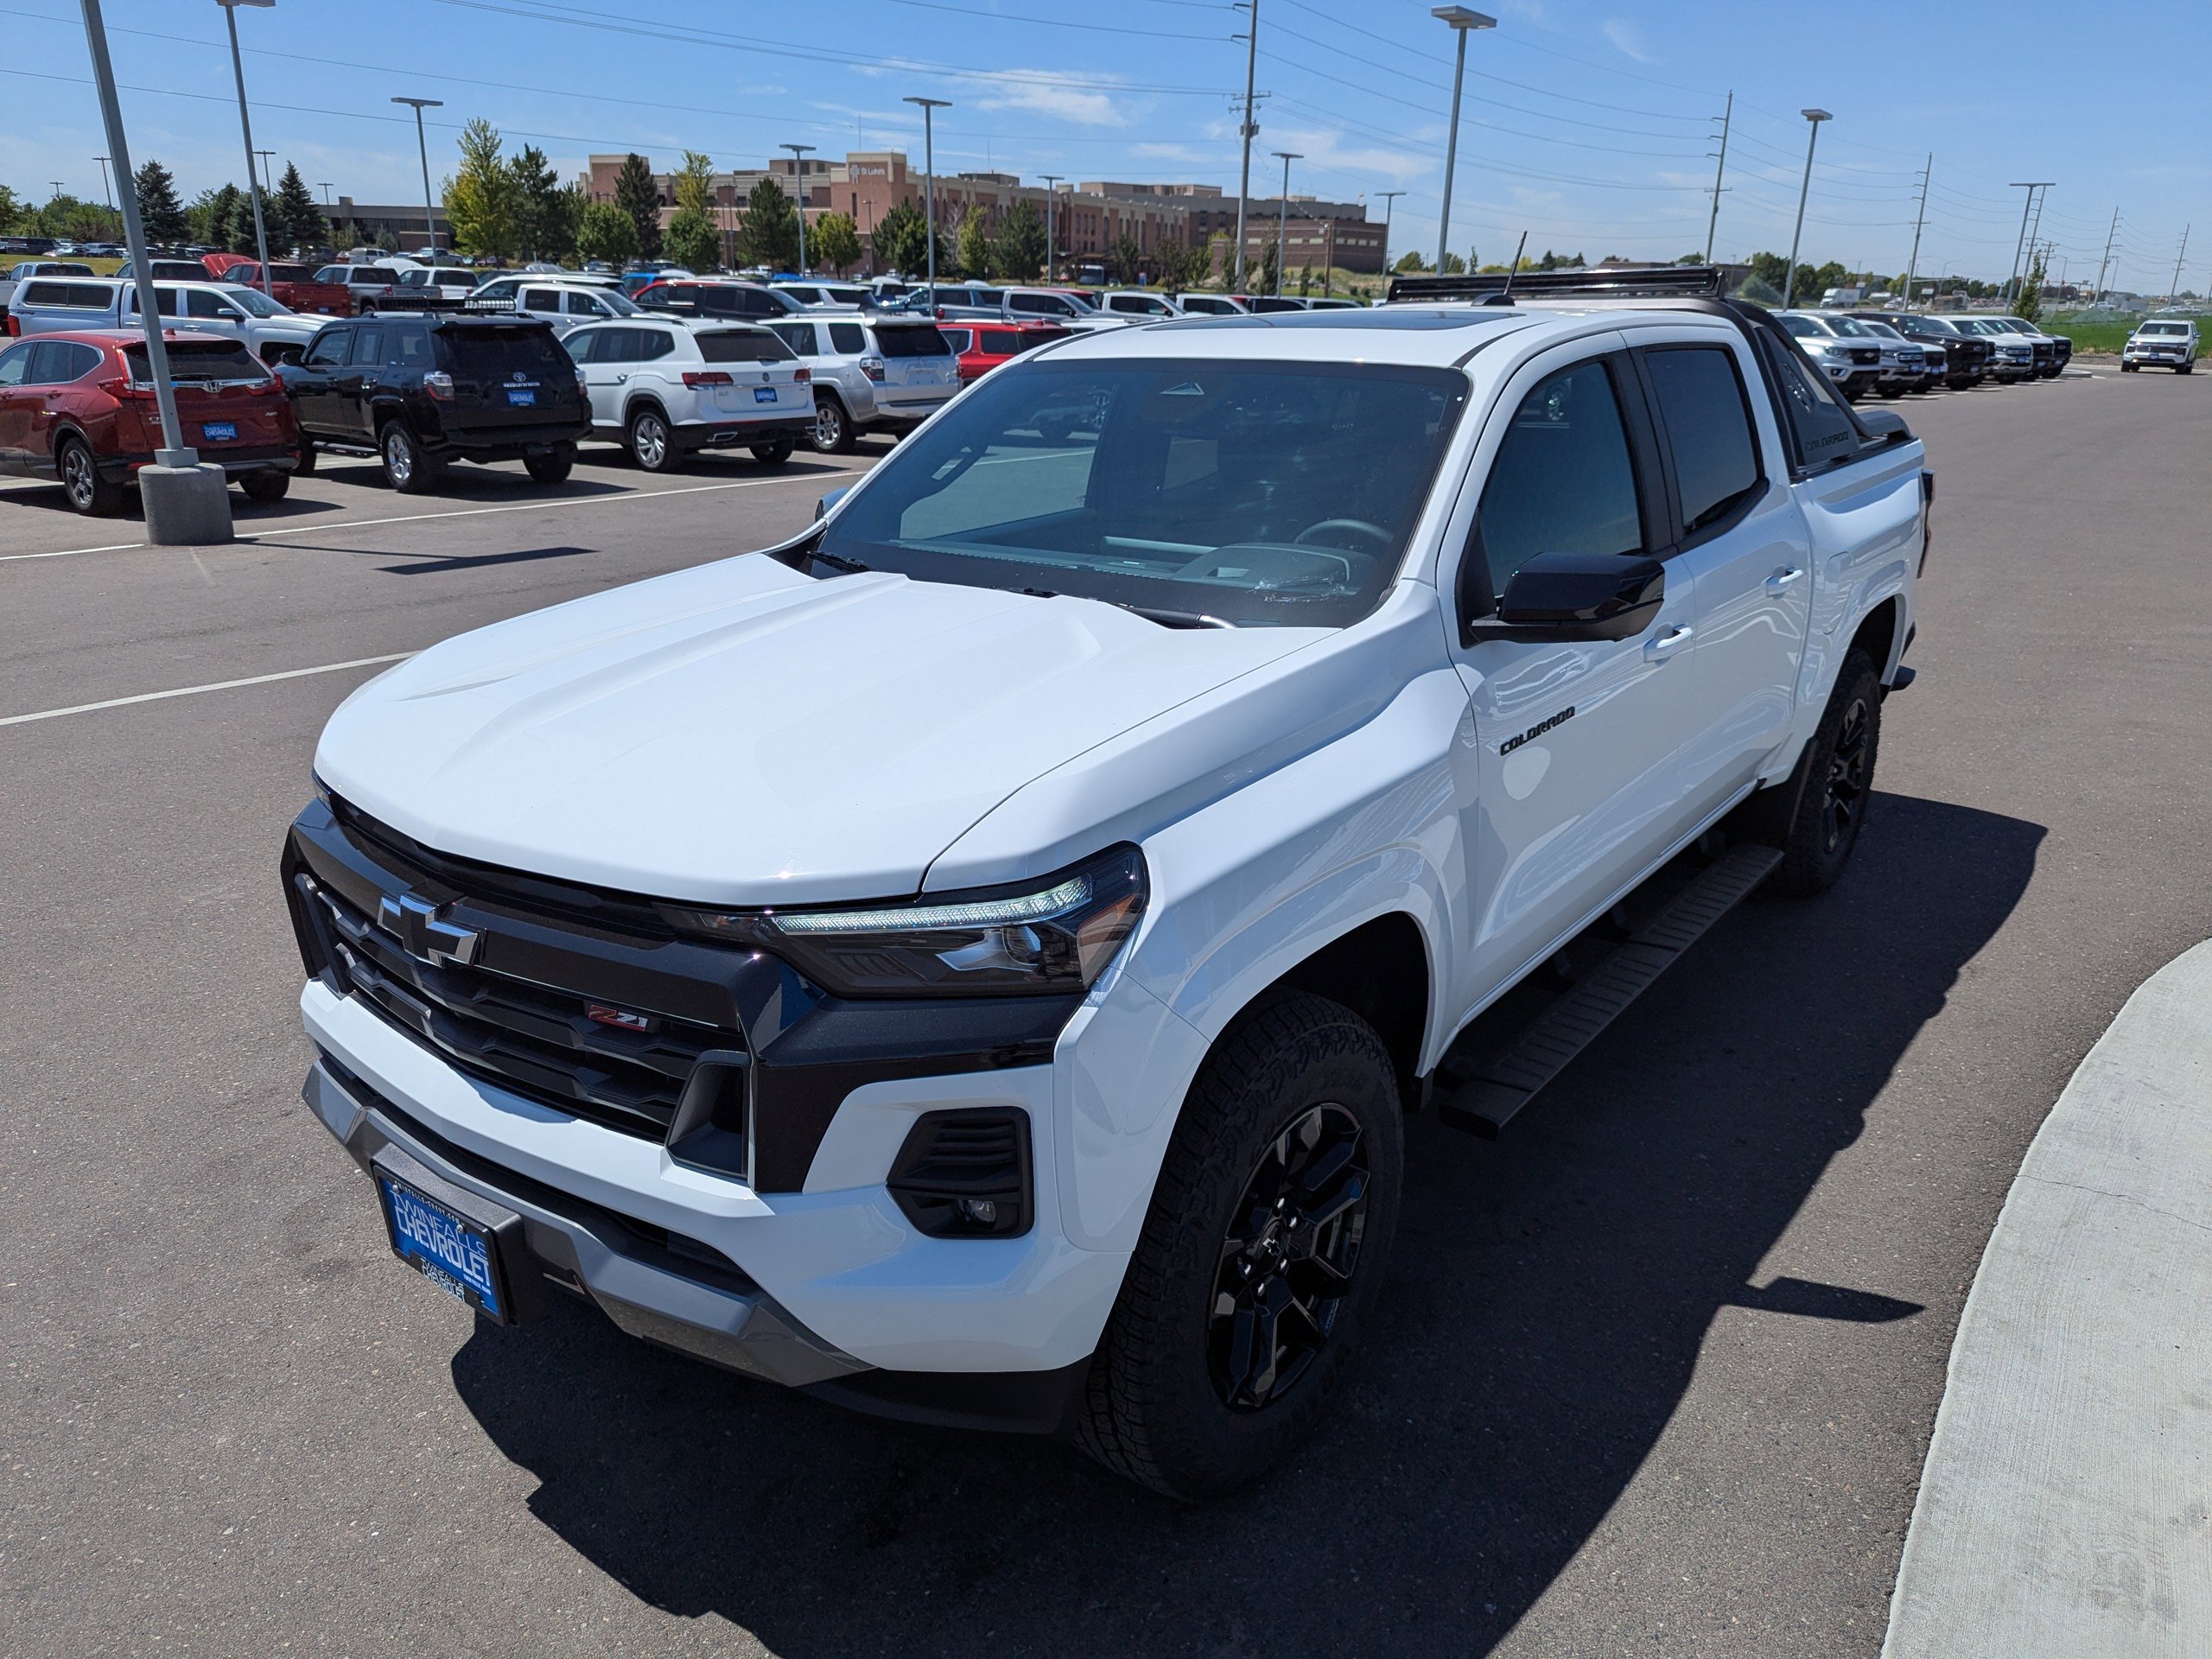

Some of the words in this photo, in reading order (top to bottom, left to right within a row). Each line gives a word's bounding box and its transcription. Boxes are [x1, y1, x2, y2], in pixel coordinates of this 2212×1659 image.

[1805, 431, 1848, 450] COLORADO
[1500, 706, 1575, 756] COLORADO
[395, 1205, 490, 1287] CHEVROLET
